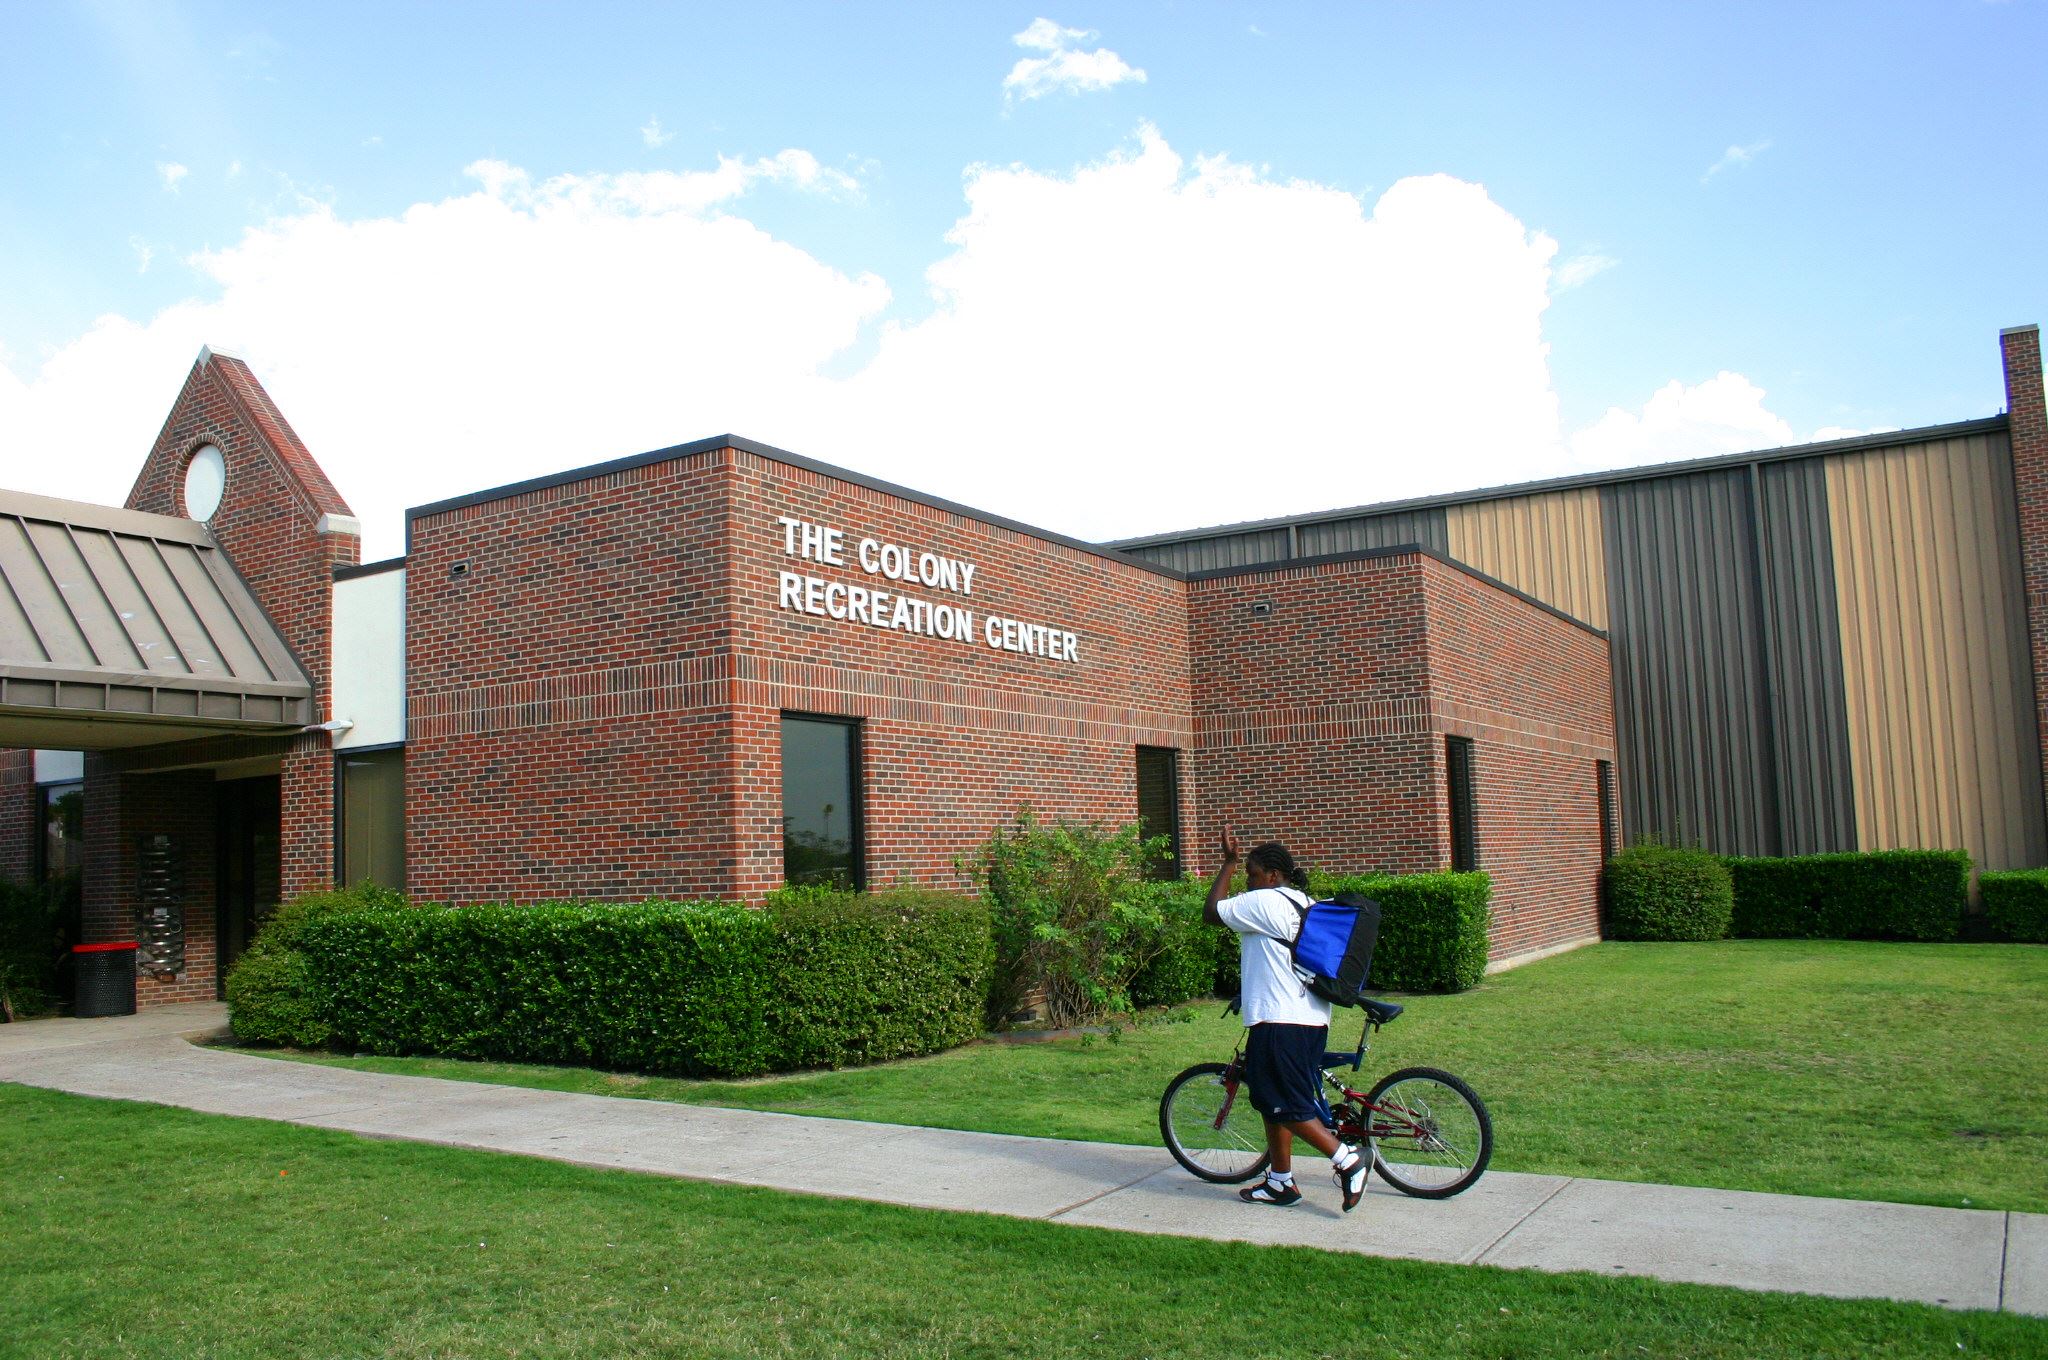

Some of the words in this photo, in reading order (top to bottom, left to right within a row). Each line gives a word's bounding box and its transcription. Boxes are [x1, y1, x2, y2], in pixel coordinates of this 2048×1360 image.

[778, 516, 843, 566] THE
[858, 537, 975, 595] COLONY
[779, 571, 972, 643] RECREATION
[984, 616, 1078, 662] CENTER
